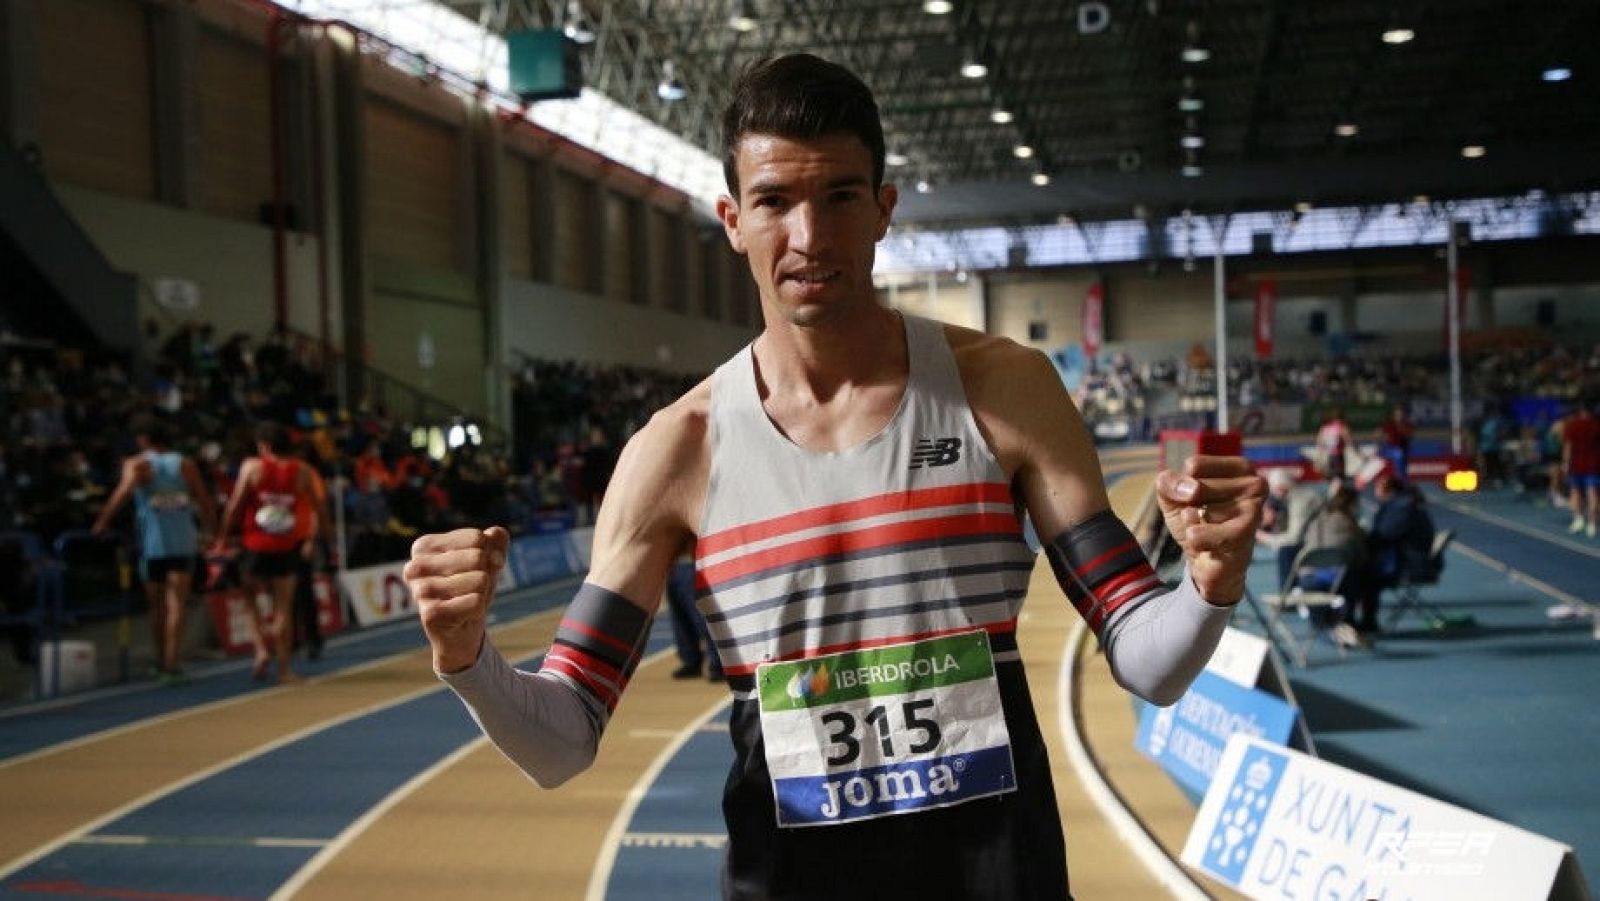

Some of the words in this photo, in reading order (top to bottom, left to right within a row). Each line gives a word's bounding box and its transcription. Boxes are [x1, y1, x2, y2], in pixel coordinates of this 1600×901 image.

[834, 653, 960, 689] IBERDROLA
[821, 698, 942, 766] 315
[1283, 775, 1412, 870] XUNTA
[1258, 838, 1312, 900] DE
